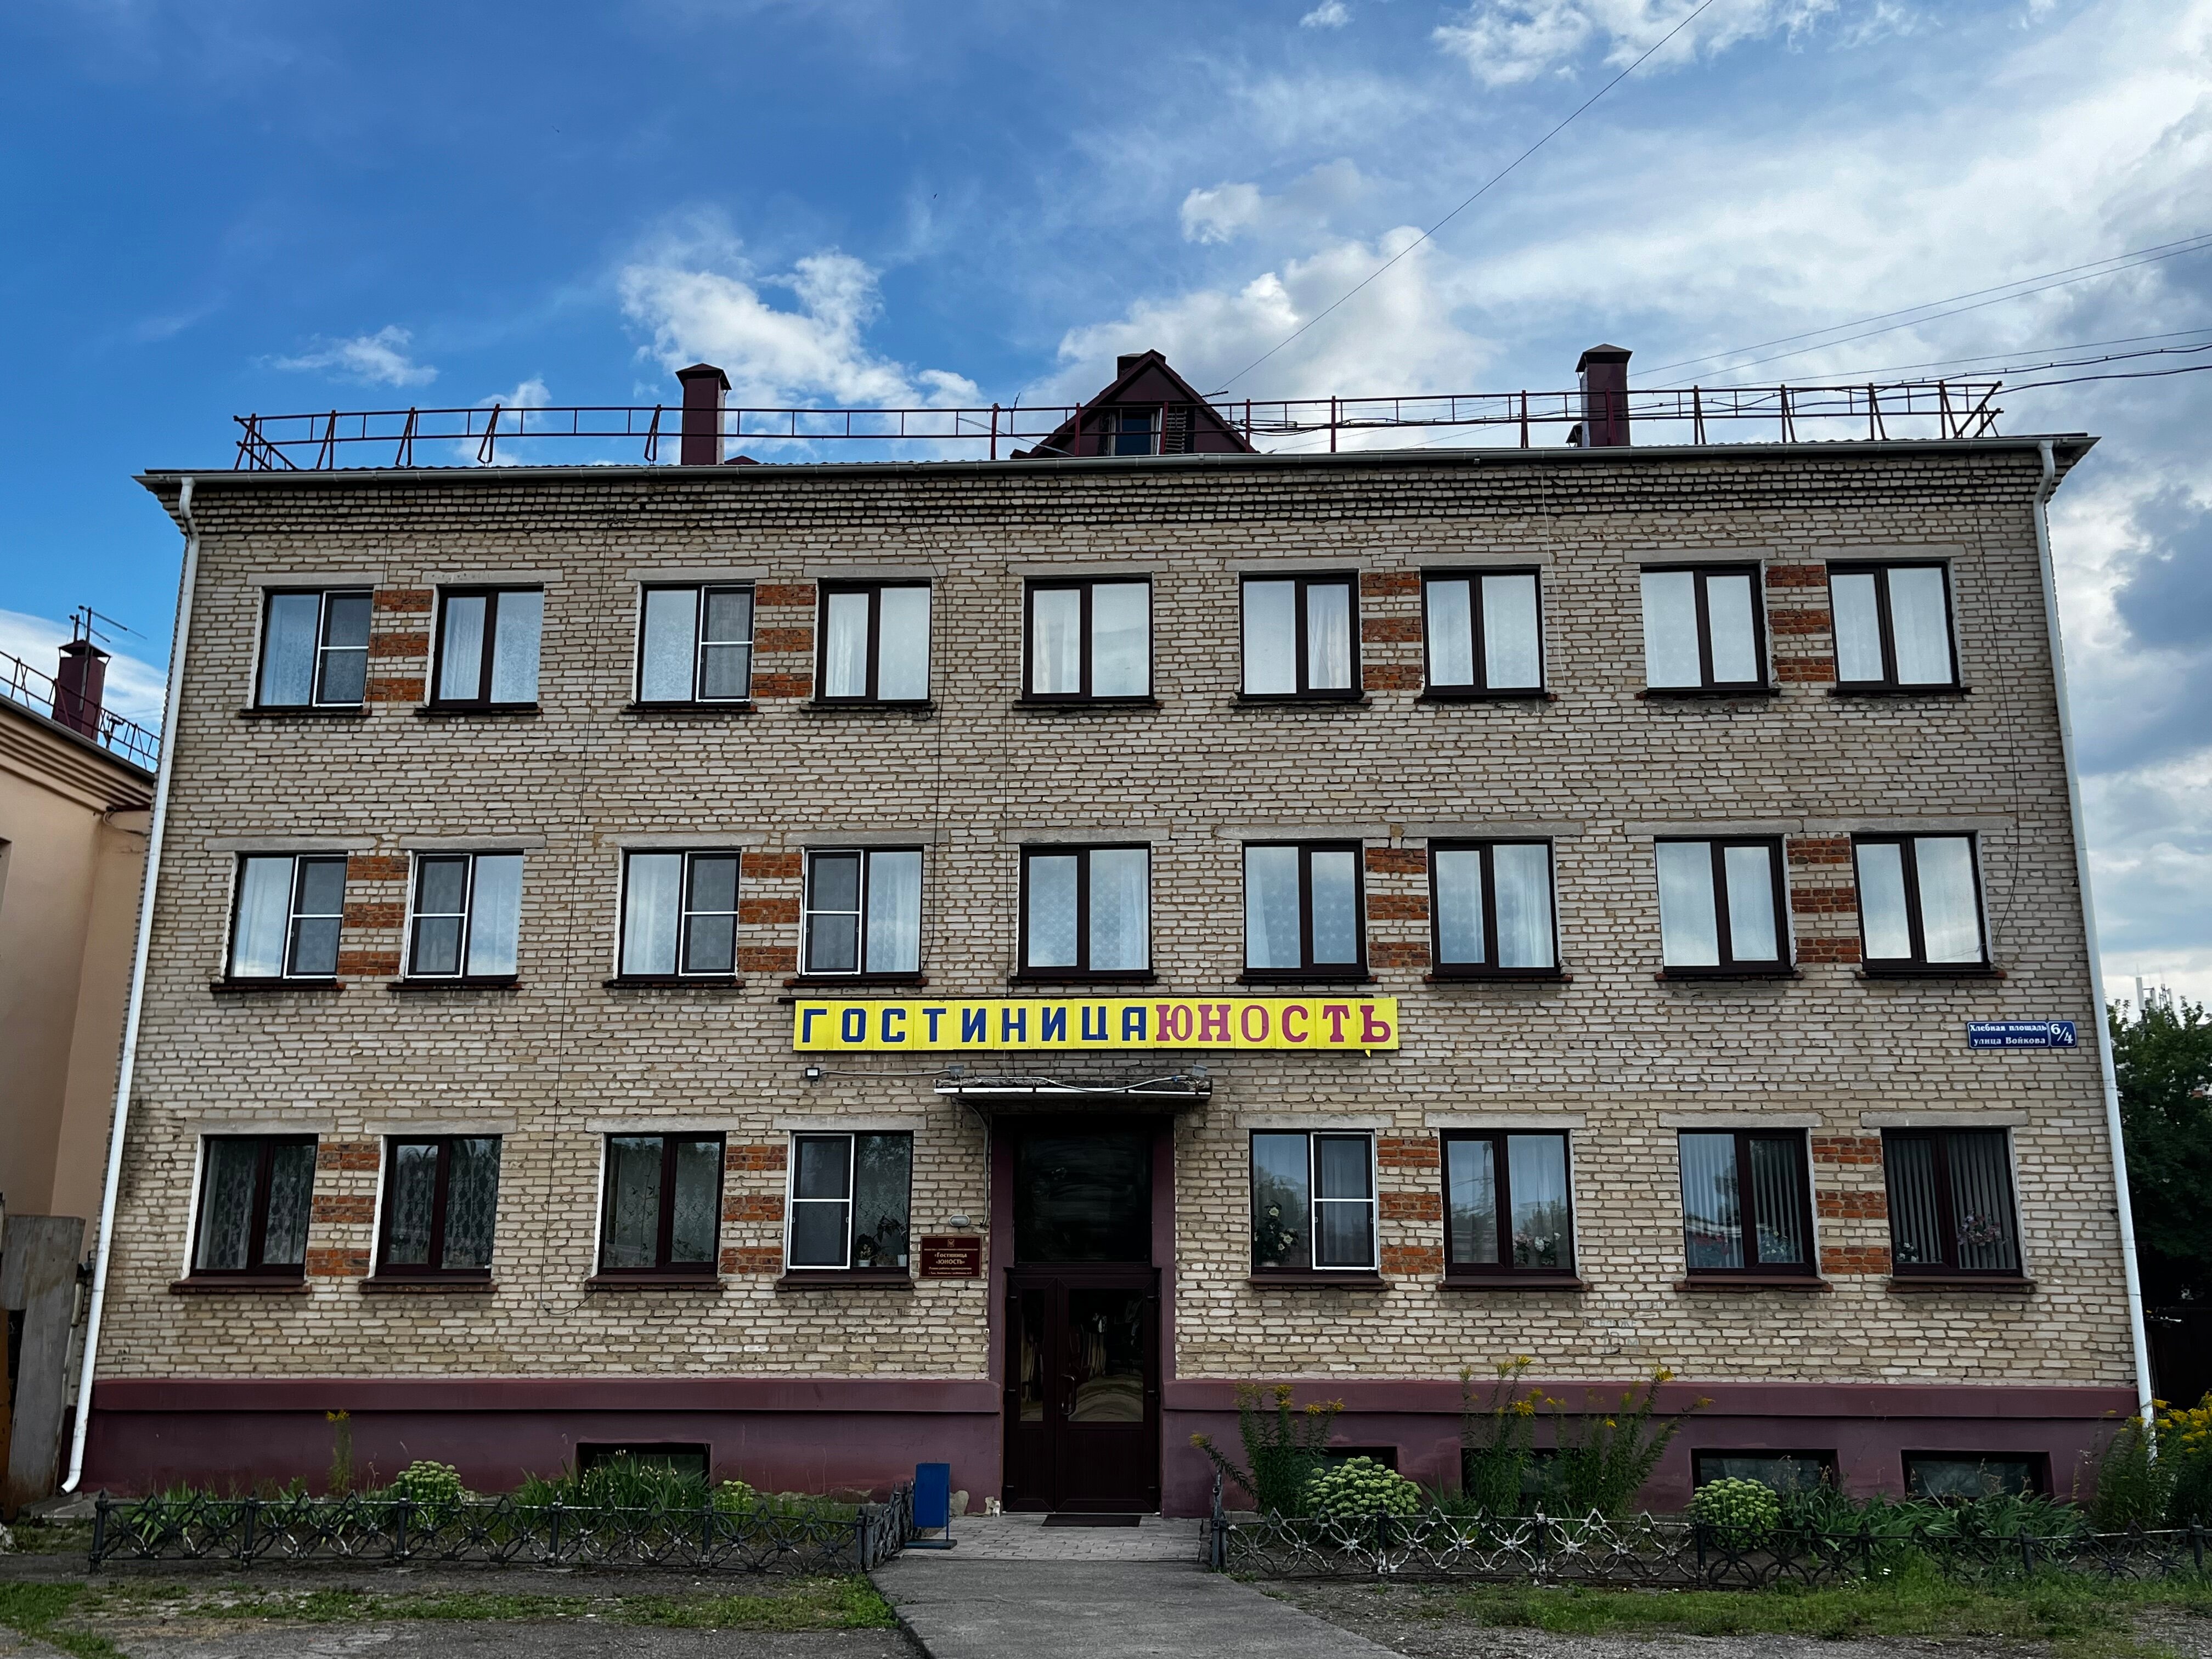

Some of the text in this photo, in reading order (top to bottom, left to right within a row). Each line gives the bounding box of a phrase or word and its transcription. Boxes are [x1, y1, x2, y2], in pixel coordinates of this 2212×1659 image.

[802, 1003, 1392, 1043] ГОСТИНИЦА ЮНОСТЬ
[1970, 1024, 2006, 1032] Хлебная
[1973, 1036, 2046, 1046] улица Войкова
[2050, 1023, 2074, 1044] 6/4
